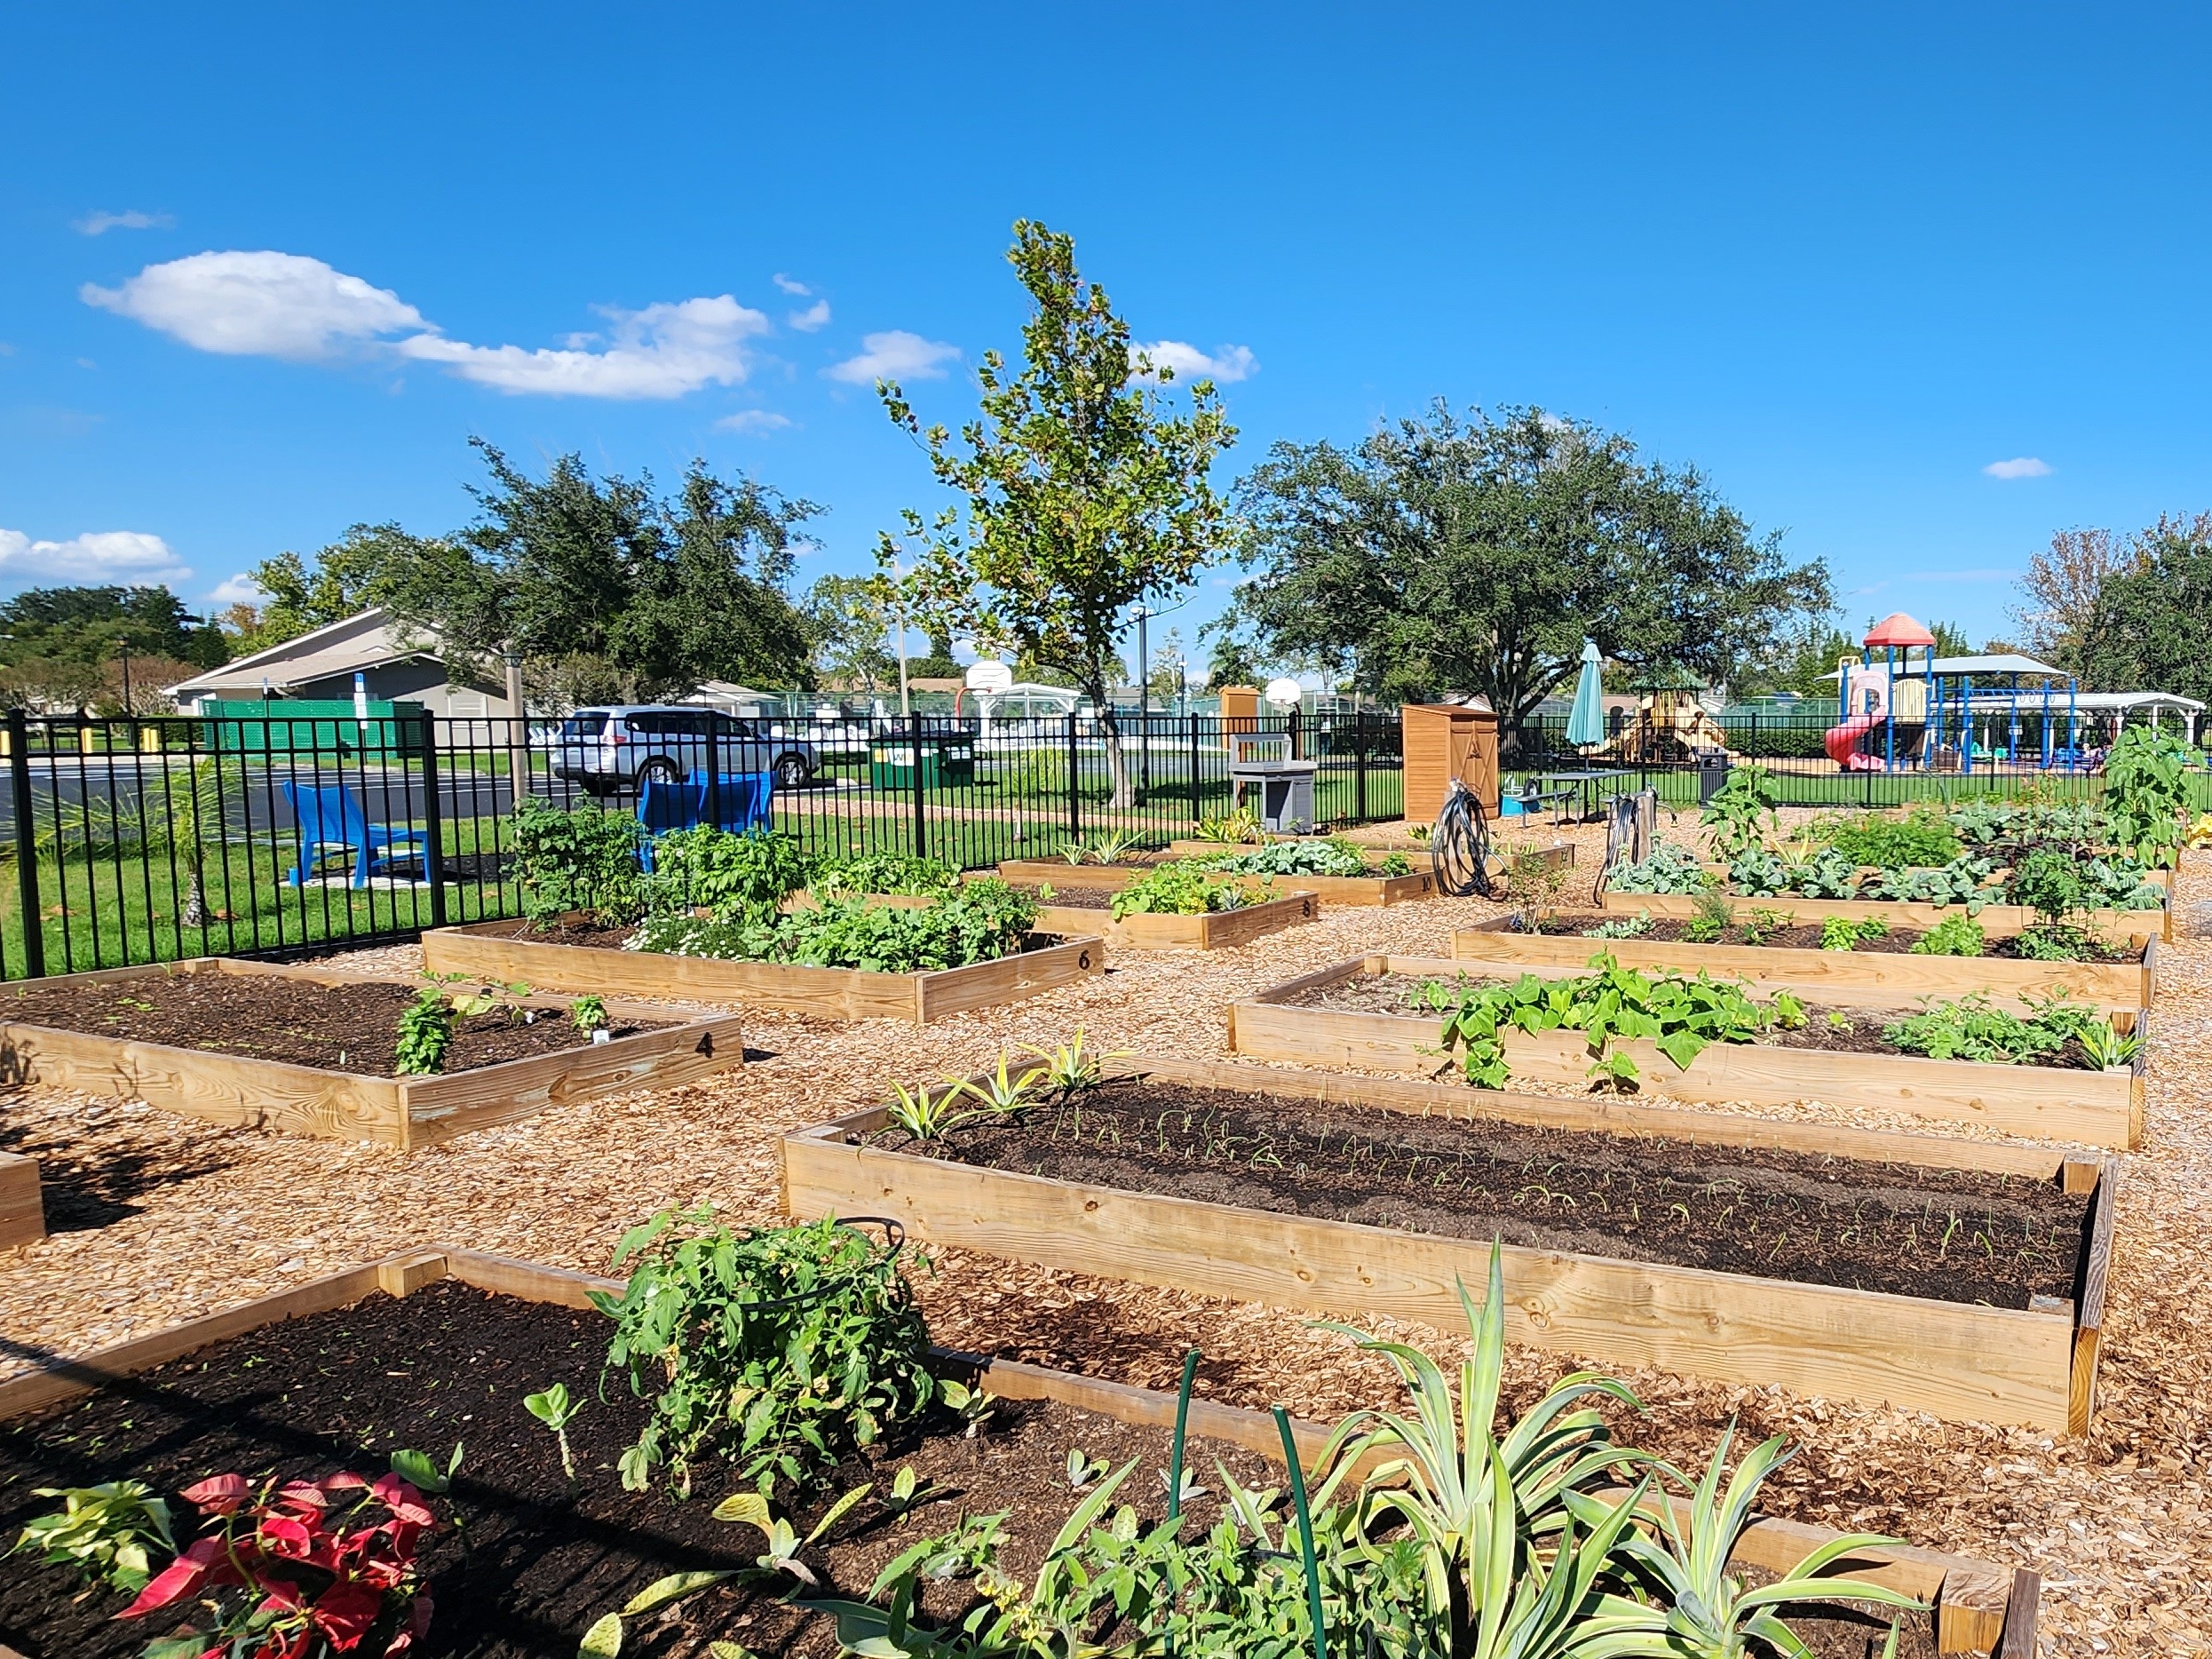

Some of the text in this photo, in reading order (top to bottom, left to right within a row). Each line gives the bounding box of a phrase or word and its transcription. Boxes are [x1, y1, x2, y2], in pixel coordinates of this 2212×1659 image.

[1422, 876, 1431, 892] 10
[1303, 900, 1311, 917] 8
[1079, 949, 1090, 970] 6
[695, 1032, 715, 1059] 4
